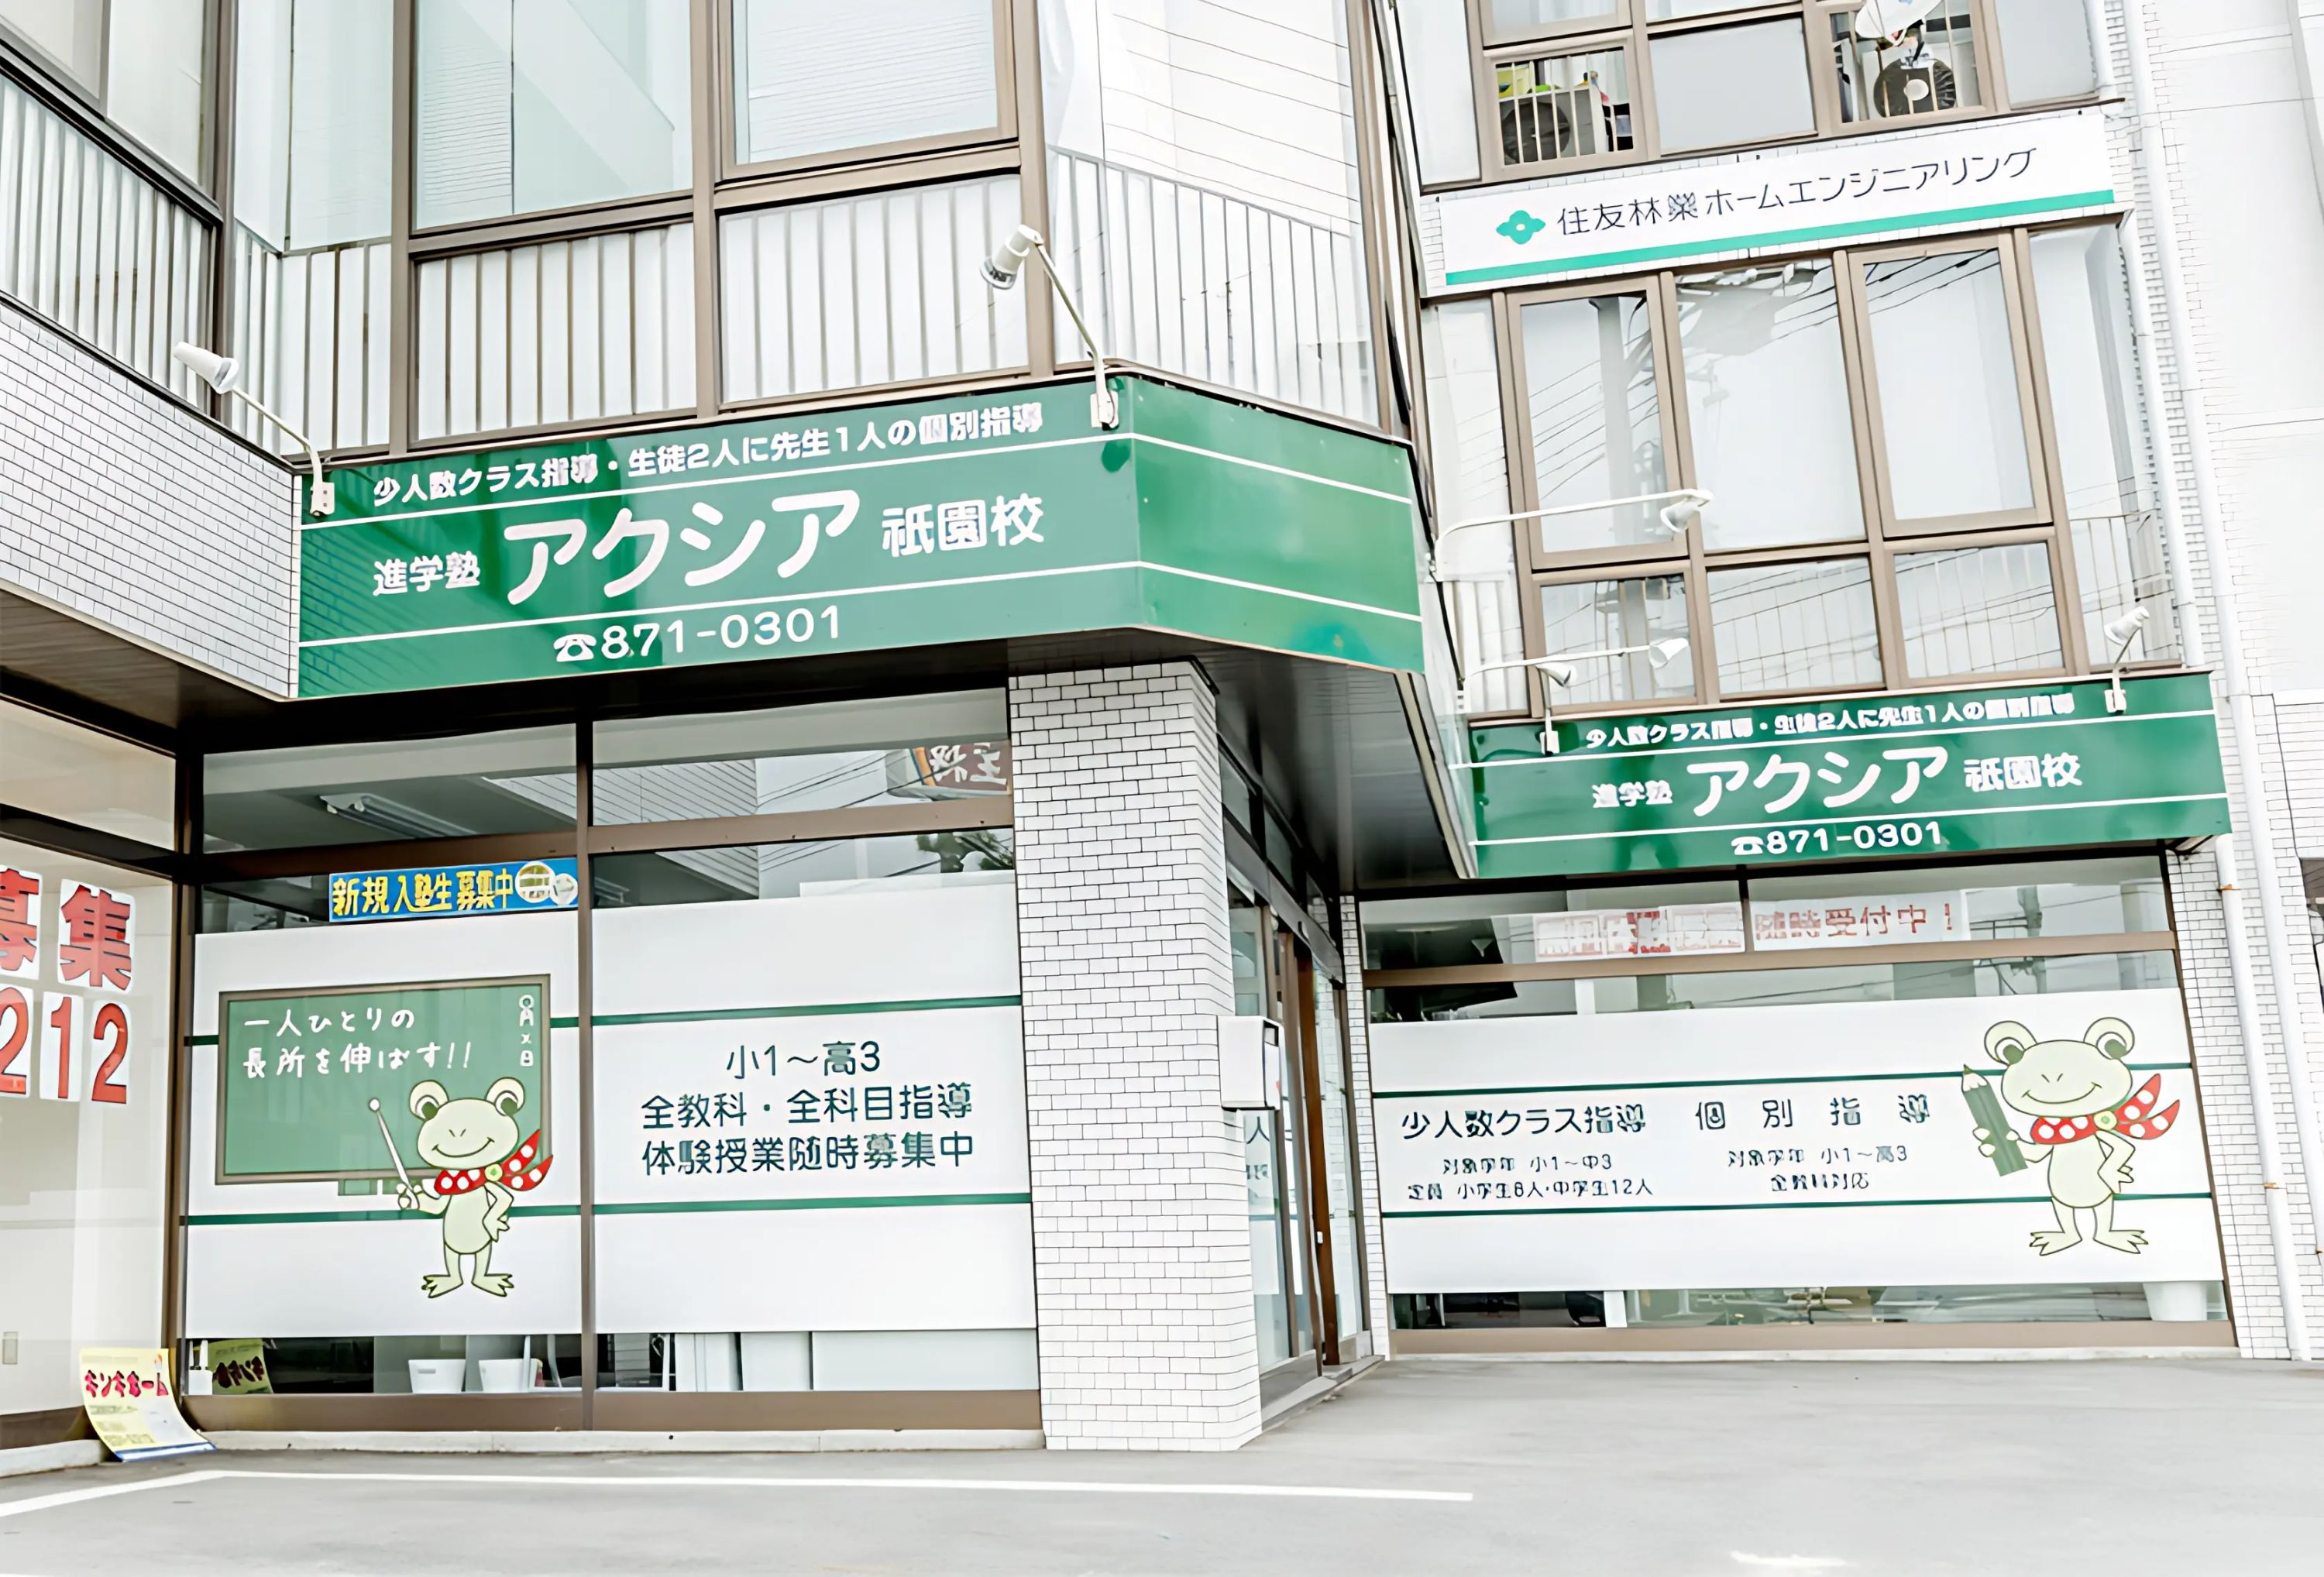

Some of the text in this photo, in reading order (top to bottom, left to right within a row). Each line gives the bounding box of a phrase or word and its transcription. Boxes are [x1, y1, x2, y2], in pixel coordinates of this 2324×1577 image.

[373, 551, 480, 597] 進学塾
[504, 490, 860, 606] アクシア
[601, 605, 839, 659] 871-0301
[1687, 746, 1949, 817] アクシア
[1767, 821, 1941, 855] 871-0301
[244, 1006, 415, 1037] 一人ひとりの
